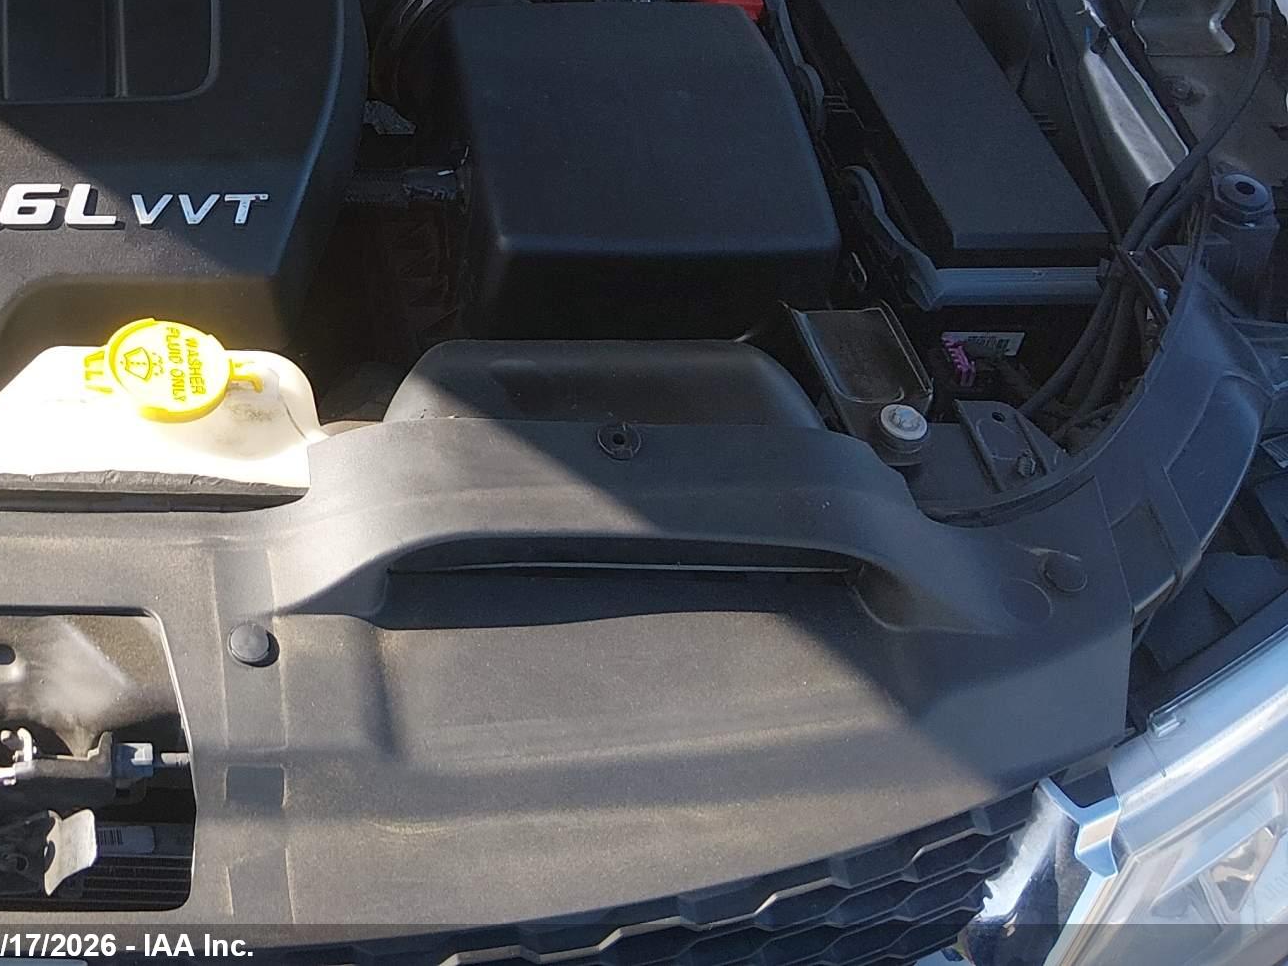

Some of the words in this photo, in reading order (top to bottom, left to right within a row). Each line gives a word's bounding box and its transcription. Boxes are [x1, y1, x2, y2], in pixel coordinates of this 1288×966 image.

[165, 326, 184, 365] FLUID
[170, 367, 187, 402] ONLY
[185, 337, 207, 395] WASHER
